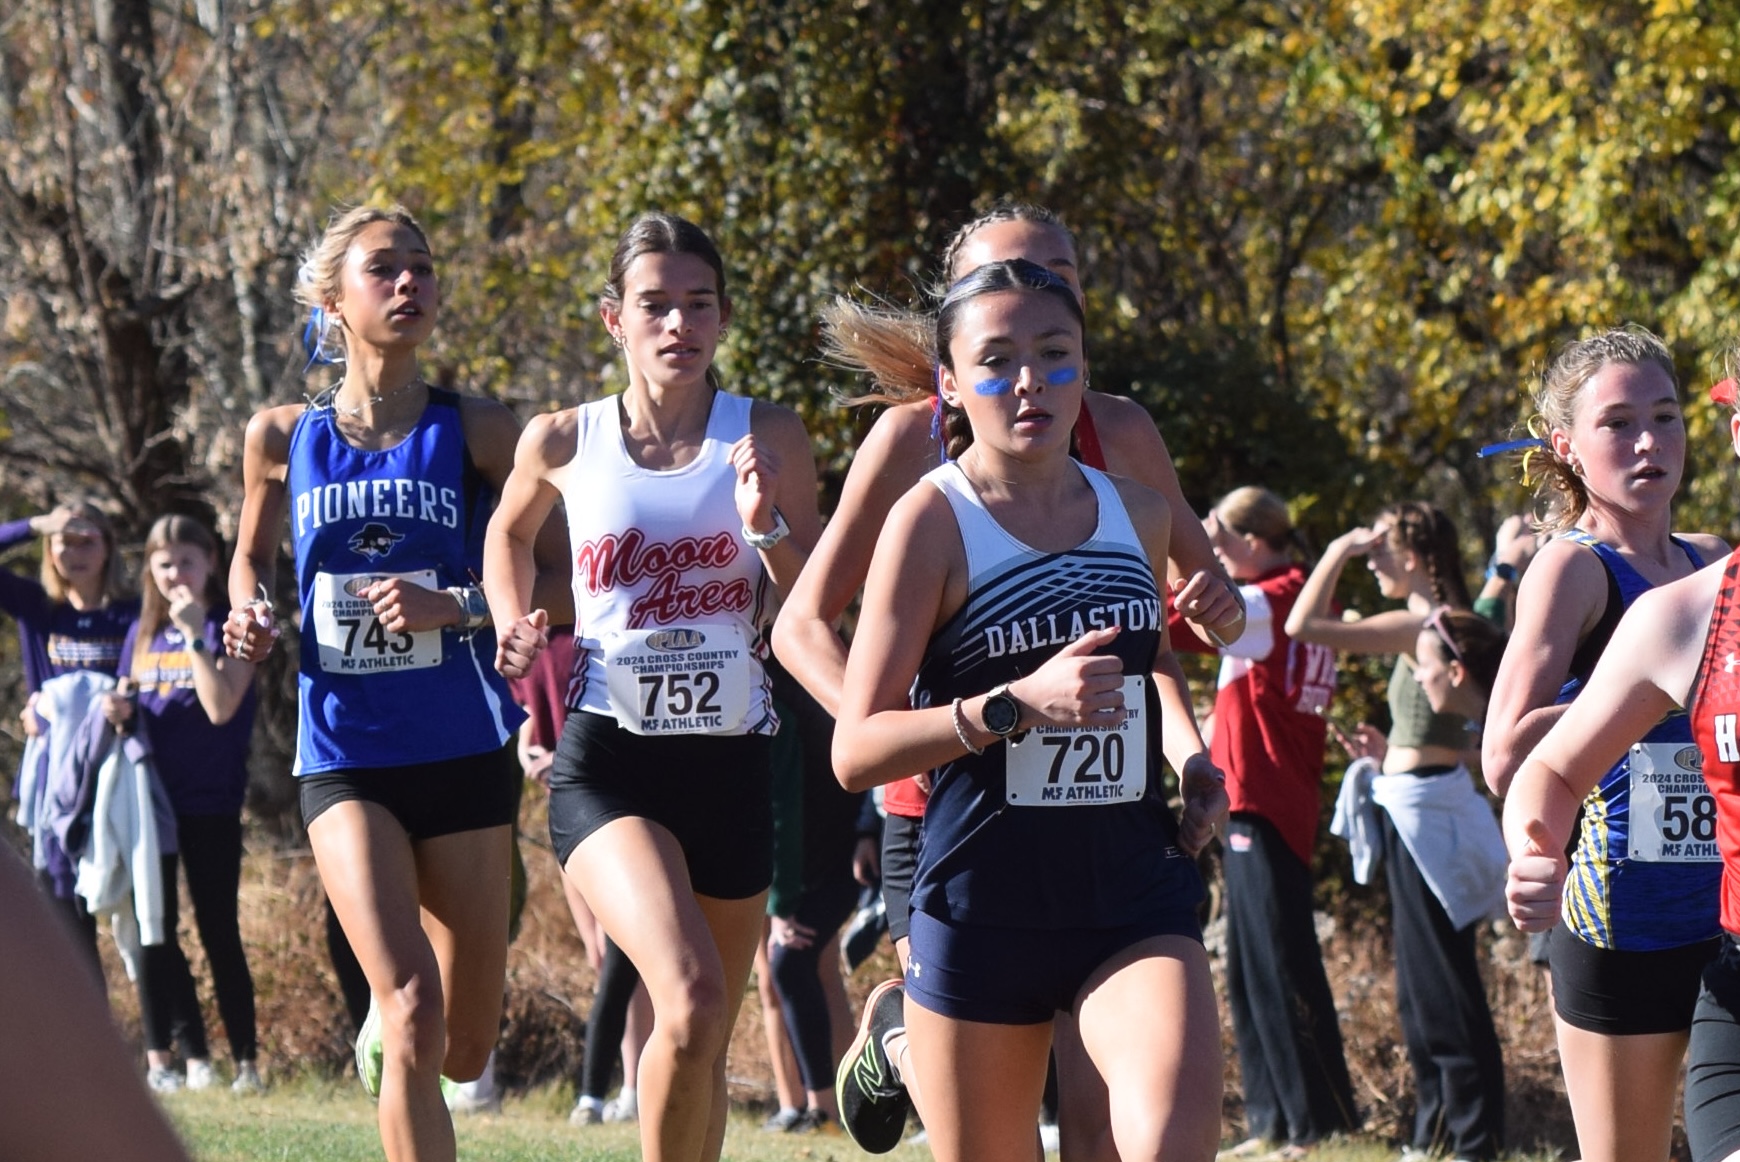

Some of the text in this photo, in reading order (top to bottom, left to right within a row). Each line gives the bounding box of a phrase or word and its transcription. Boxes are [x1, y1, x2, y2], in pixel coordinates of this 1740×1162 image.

[296, 479, 458, 538] PIONEERS
[576, 527, 739, 598] Moon
[345, 600, 374, 609] CROS
[626, 570, 753, 630] Area
[337, 617, 414, 657] 743
[984, 599, 1162, 659] DALLASTOW
[652, 630, 702, 649] PIAA
[359, 655, 415, 669] ATHLETIC
[616, 650, 739, 666] 2024 CROSS COUNTRY
[632, 660, 725, 675] CHAMPIONSHIPS
[638, 671, 722, 717] 752
[662, 715, 722, 730] ATHLETIC
[1042, 733, 1125, 784] 720
[1642, 773, 1705, 784] 2024 CROS
[1065, 784, 1124, 800] ATHLETIC
[1658, 784, 1711, 794] CHAMPIO
[1662, 795, 1718, 842] 58
[1684, 843, 1721, 857] ATHL
